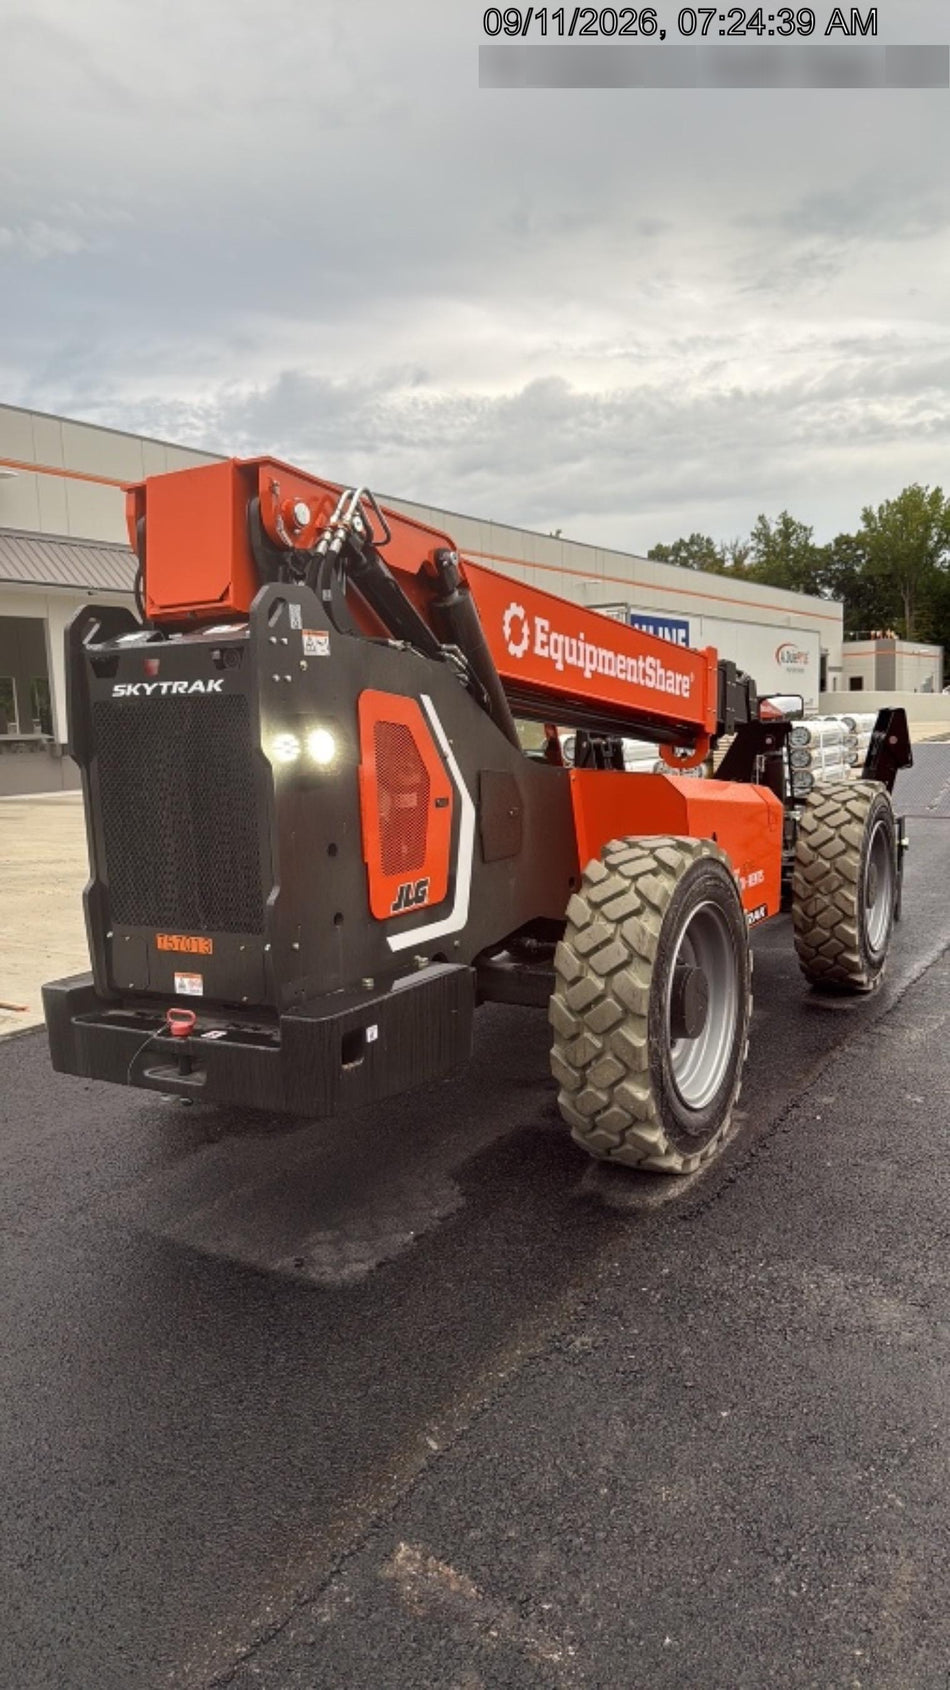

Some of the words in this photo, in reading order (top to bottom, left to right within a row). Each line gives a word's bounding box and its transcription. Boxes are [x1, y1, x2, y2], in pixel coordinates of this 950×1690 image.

[533, 616, 691, 697] EquipmentShare
[112, 679, 224, 697] SKYTRAK
[391, 877, 430, 914] JLG
